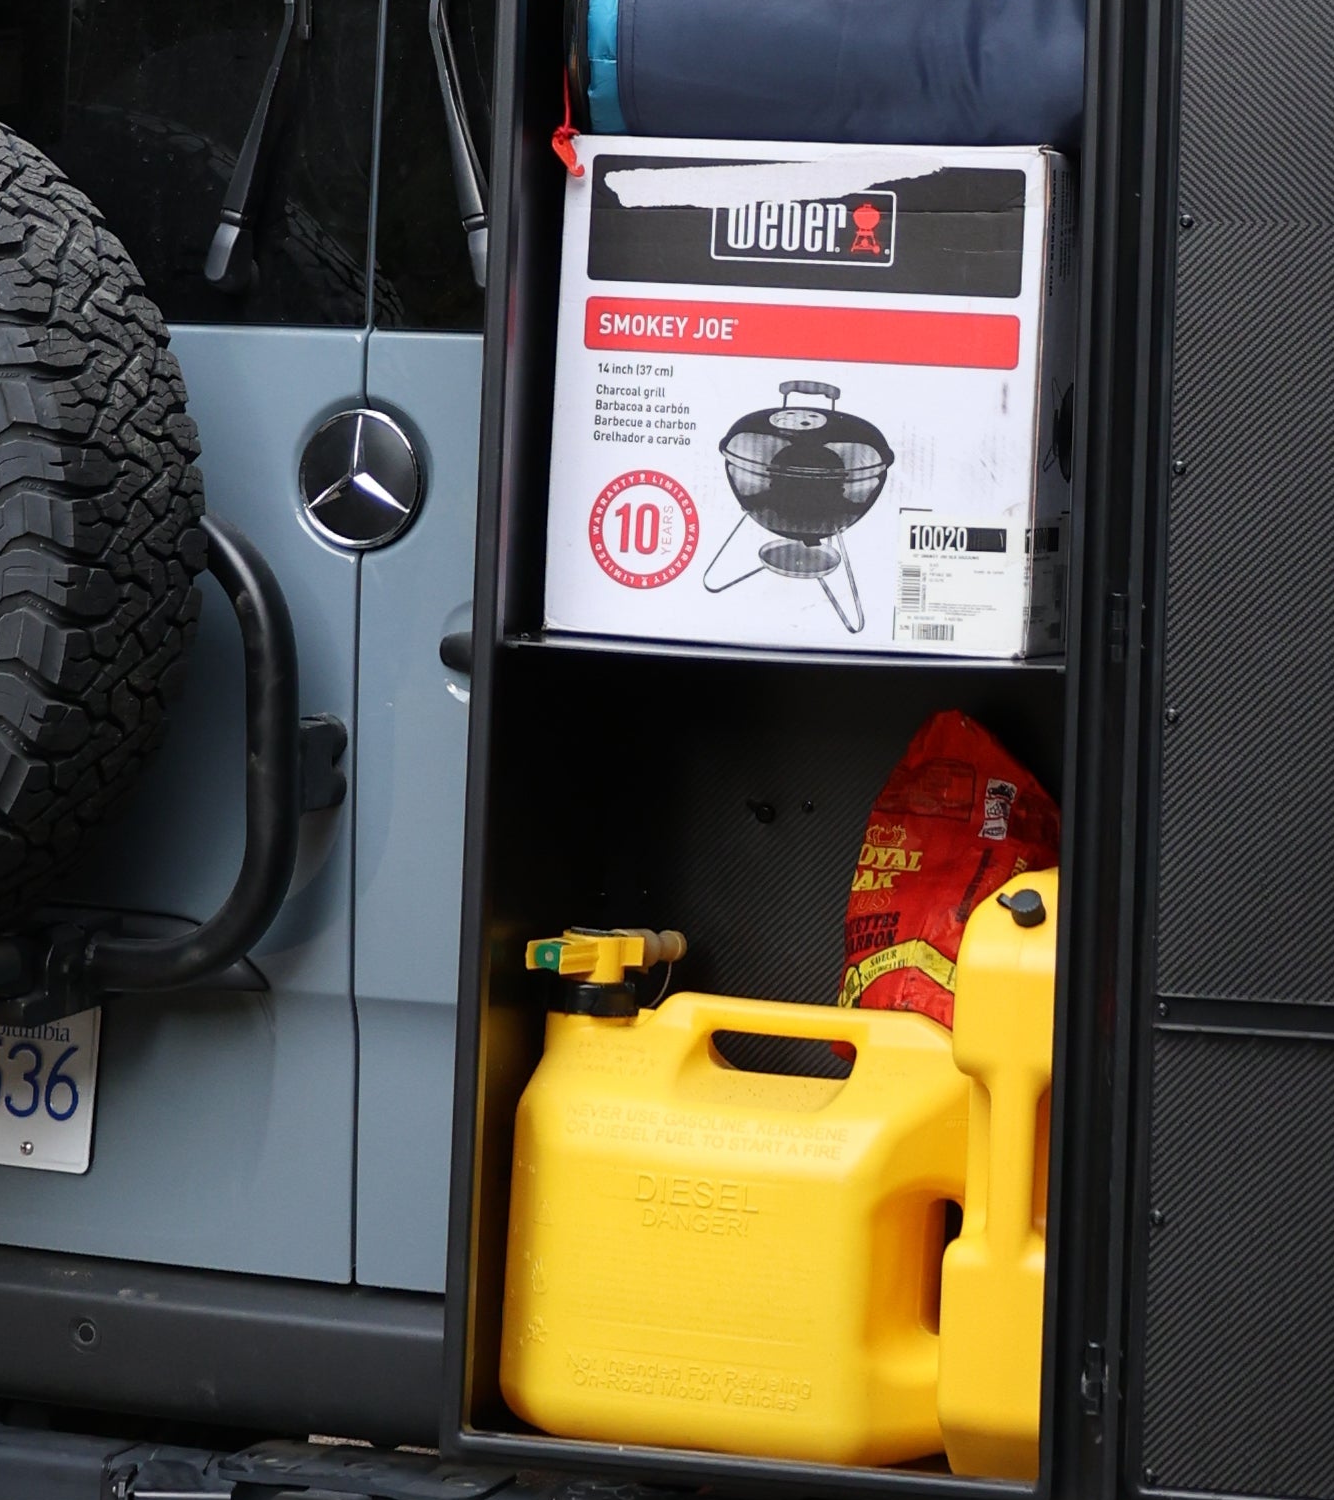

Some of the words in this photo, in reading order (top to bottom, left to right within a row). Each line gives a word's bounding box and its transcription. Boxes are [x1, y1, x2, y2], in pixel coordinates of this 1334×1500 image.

[599, 313, 688, 338] SMOKEY
[598, 363, 609, 373] 14
[612, 364, 633, 375] inch
[636, 364, 652, 376] (37
[654, 365, 674, 377] cm)
[595, 399, 643, 412] Barbacoa
[646, 405, 651, 413] a
[654, 402, 690, 414] carbón
[596, 384, 641, 396] Charcoal
[644, 387, 665, 399] grill
[593, 430, 645, 443] Grelhador
[647, 436, 653, 444] a
[656, 434, 691, 445] carvão
[594, 415, 643, 427] Barbecue
[646, 420, 651, 428] a
[654, 418, 696, 430] charbon
[593, 475, 635, 535] WARRANTY
[652, 475, 693, 515] LIMITED
[614, 502, 660, 555] 10
[660, 505, 674, 555] YEARS
[910, 525, 968, 551] 10020
[595, 543, 635, 585] LIMITED
[653, 523, 696, 584] WARRANTY
[858, 843, 923, 871] OYAL
[566, 1119, 589, 1135] OR
[593, 1123, 650, 1143] DIESEL
[654, 1128, 697, 1147] FUEL
[702, 1134, 725, 1150] TO
[728, 1137, 784, 1154] START
[786, 1142, 799, 1156] A
[803, 1143, 843, 1160] FIRE
[567, 1102, 622, 1121] NEVER
[627, 1108, 660, 1125] USE
[756, 1121, 849, 1143] KEROSENE
[634, 1173, 760, 1215] DIESEL
[641, 1207, 750, 1239] DANGER!
[566, 1352, 596, 1371] Not
[602, 1354, 681, 1383] Intended
[688, 1366, 720, 1386] For
[725, 1370, 812, 1400] Refueling
[572, 1368, 655, 1396] On-Road
[661, 1379, 714, 1403] Motor
[717, 1386, 799, 1412] Vehicles
